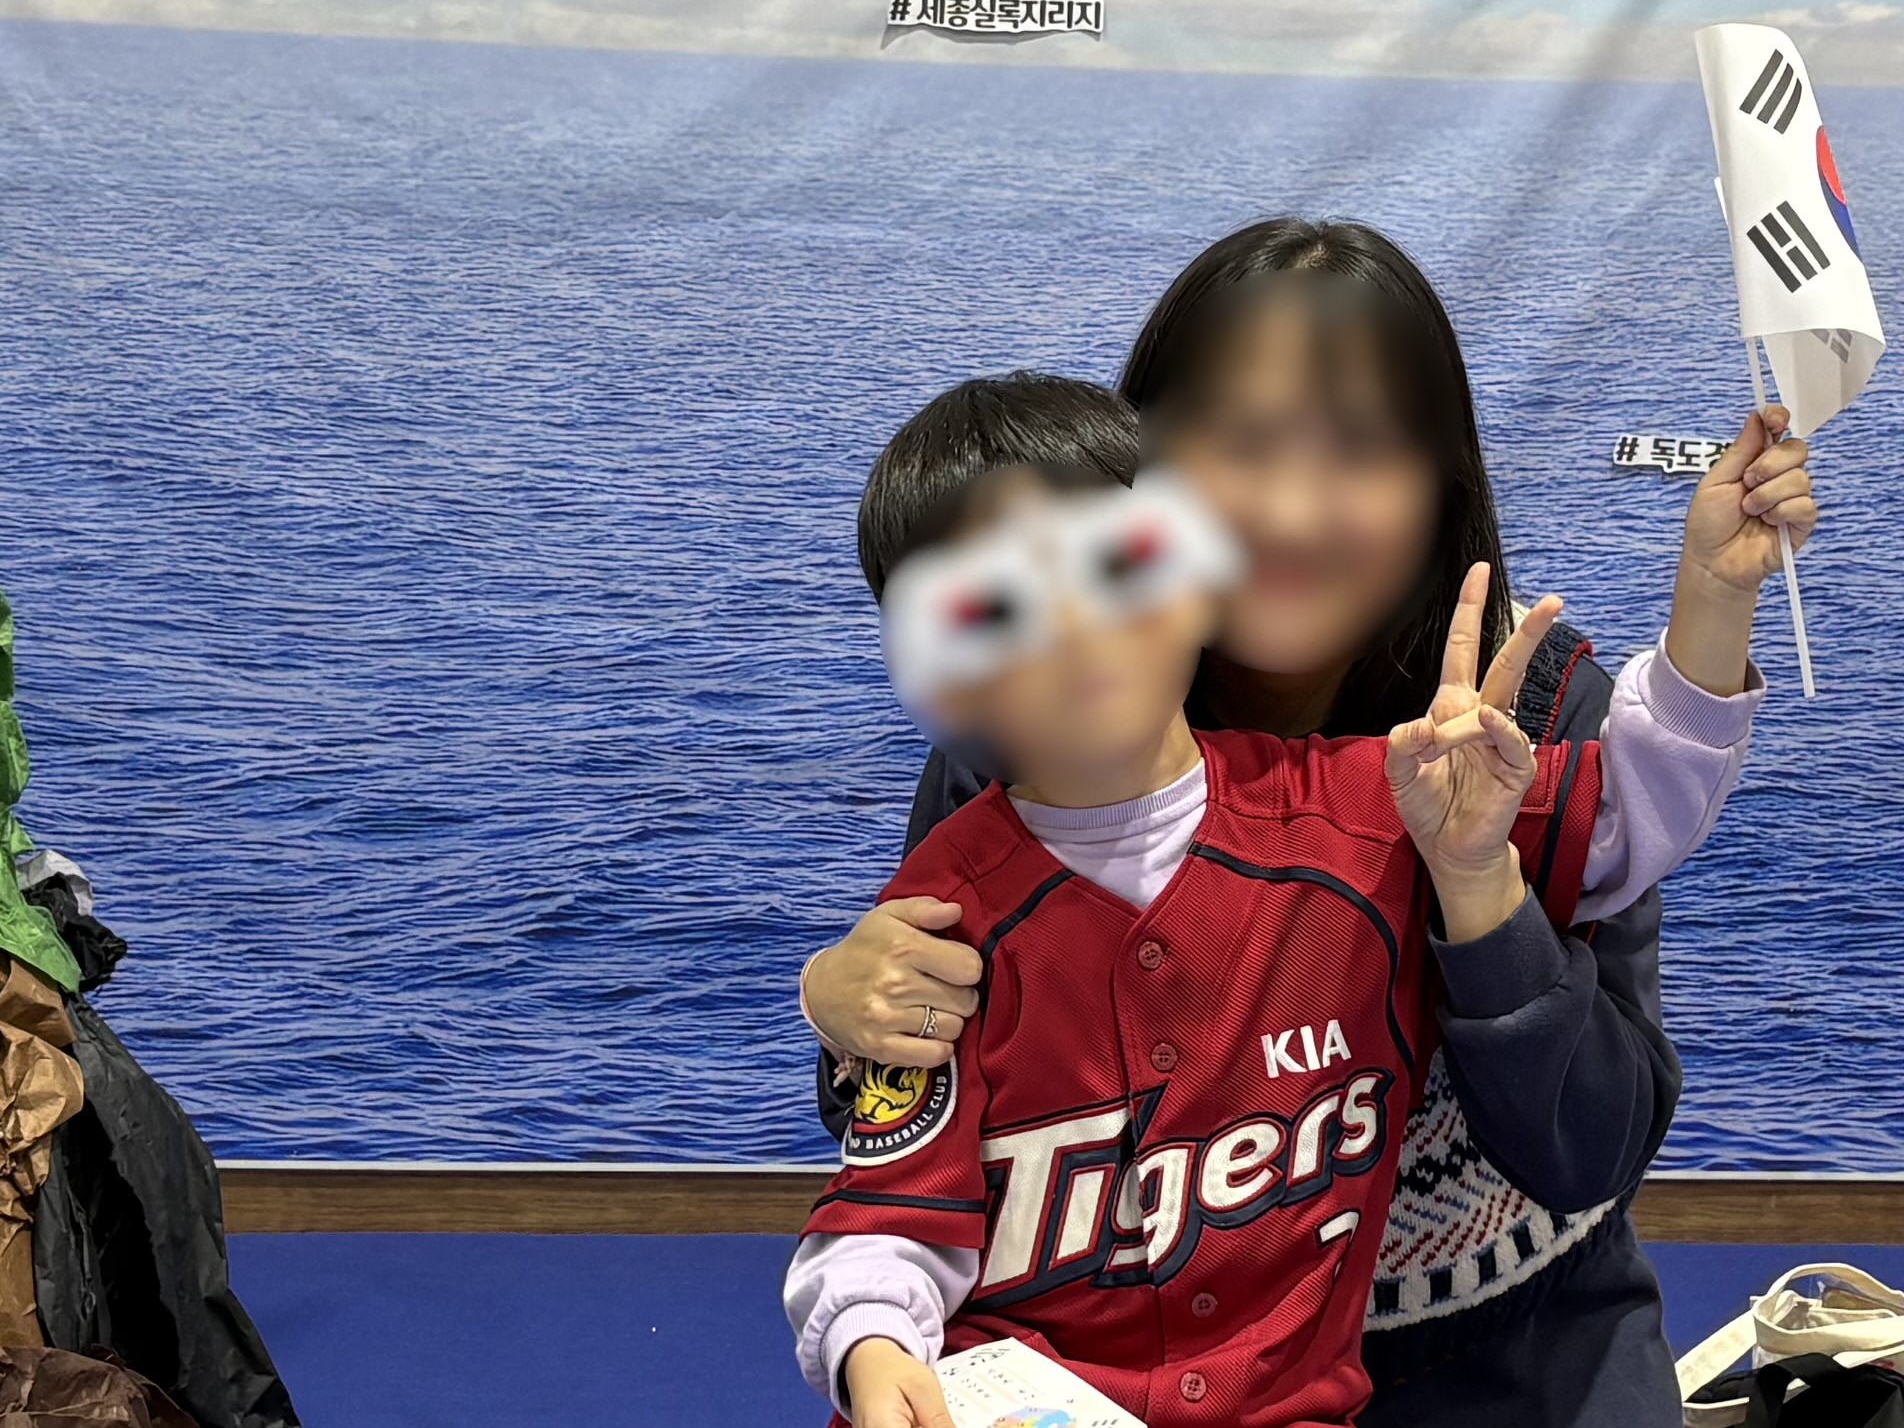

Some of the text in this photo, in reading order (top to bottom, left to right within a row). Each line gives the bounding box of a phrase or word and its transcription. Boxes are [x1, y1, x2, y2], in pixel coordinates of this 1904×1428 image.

[1616, 436, 1639, 462] #
[1261, 1019, 1352, 1079] KIA
[865, 1112, 934, 1150] BASEBALL
[929, 1075, 948, 1109] CLUB
[970, 1070, 1392, 1302] Tigers
